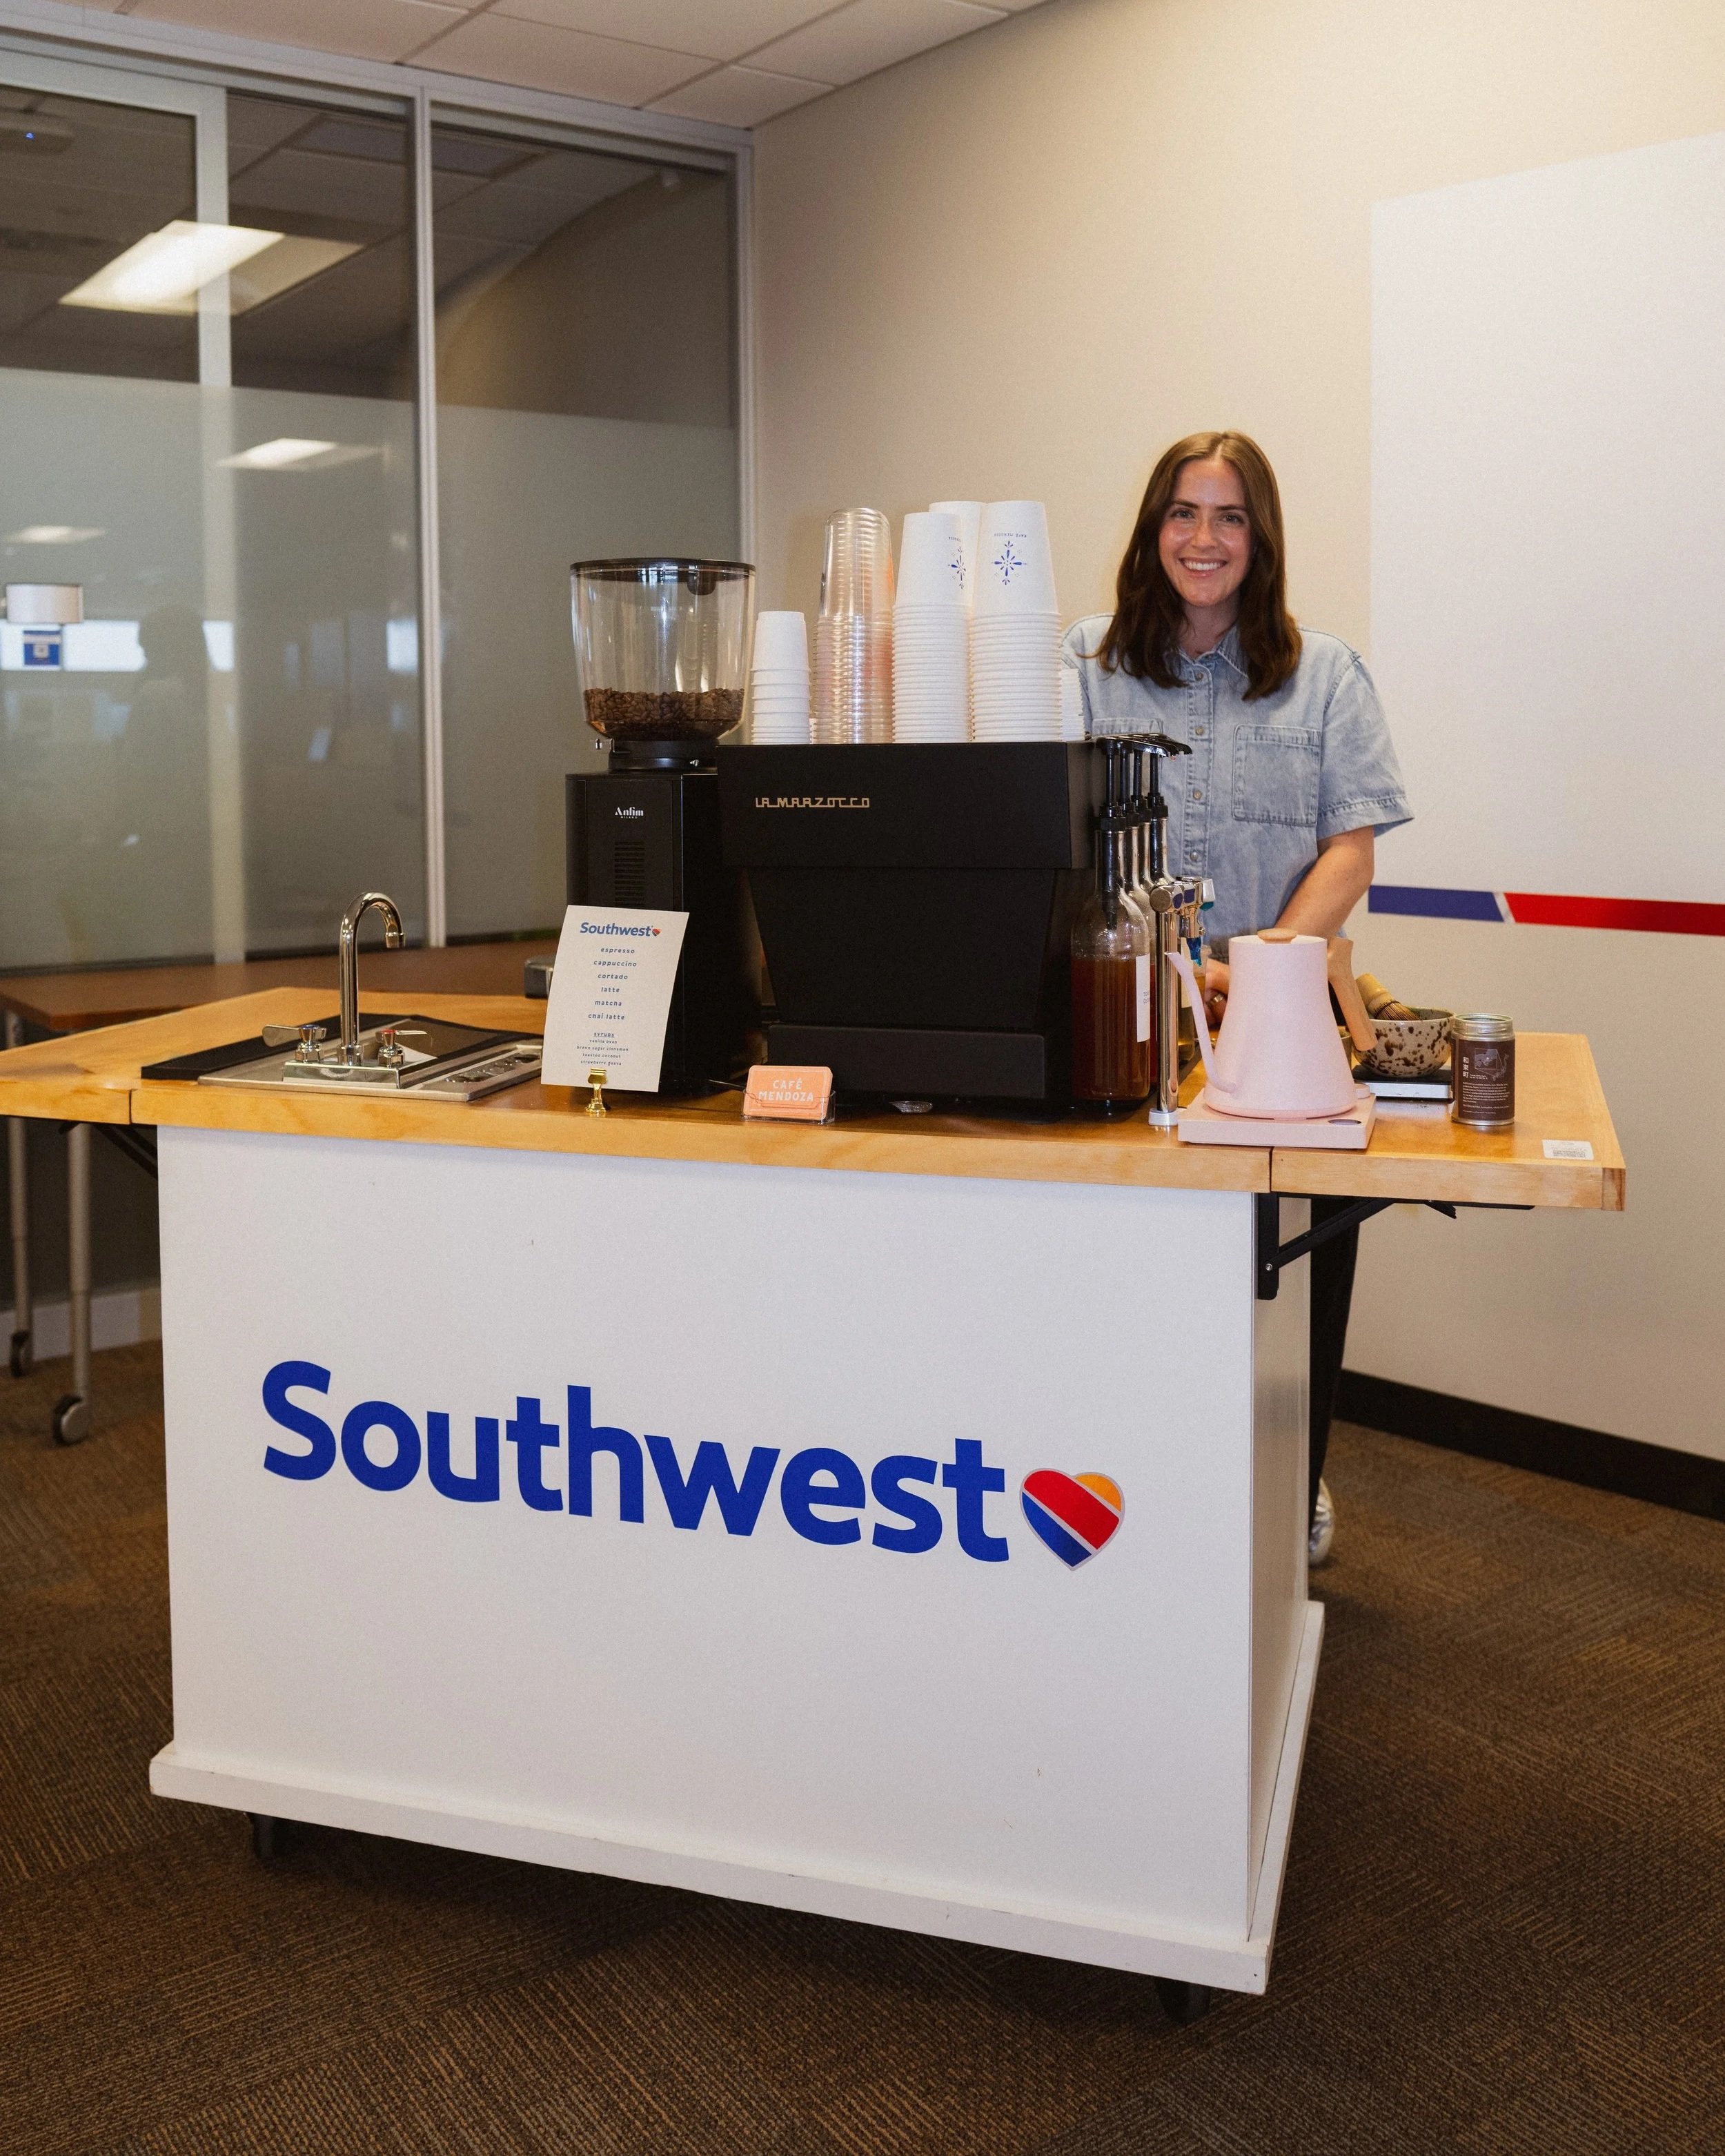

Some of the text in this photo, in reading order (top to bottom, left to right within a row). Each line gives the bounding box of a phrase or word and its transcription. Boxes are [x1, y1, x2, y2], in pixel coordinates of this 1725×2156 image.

[756, 797, 870, 808] LA MARZOCCO
[615, 807, 644, 816] Anfim
[580, 922, 651, 937] Southwest
[773, 1078, 803, 1090] CAFÉ
[758, 1091, 814, 1101] MENDOZA
[263, 1360, 1009, 1562] Southwest
